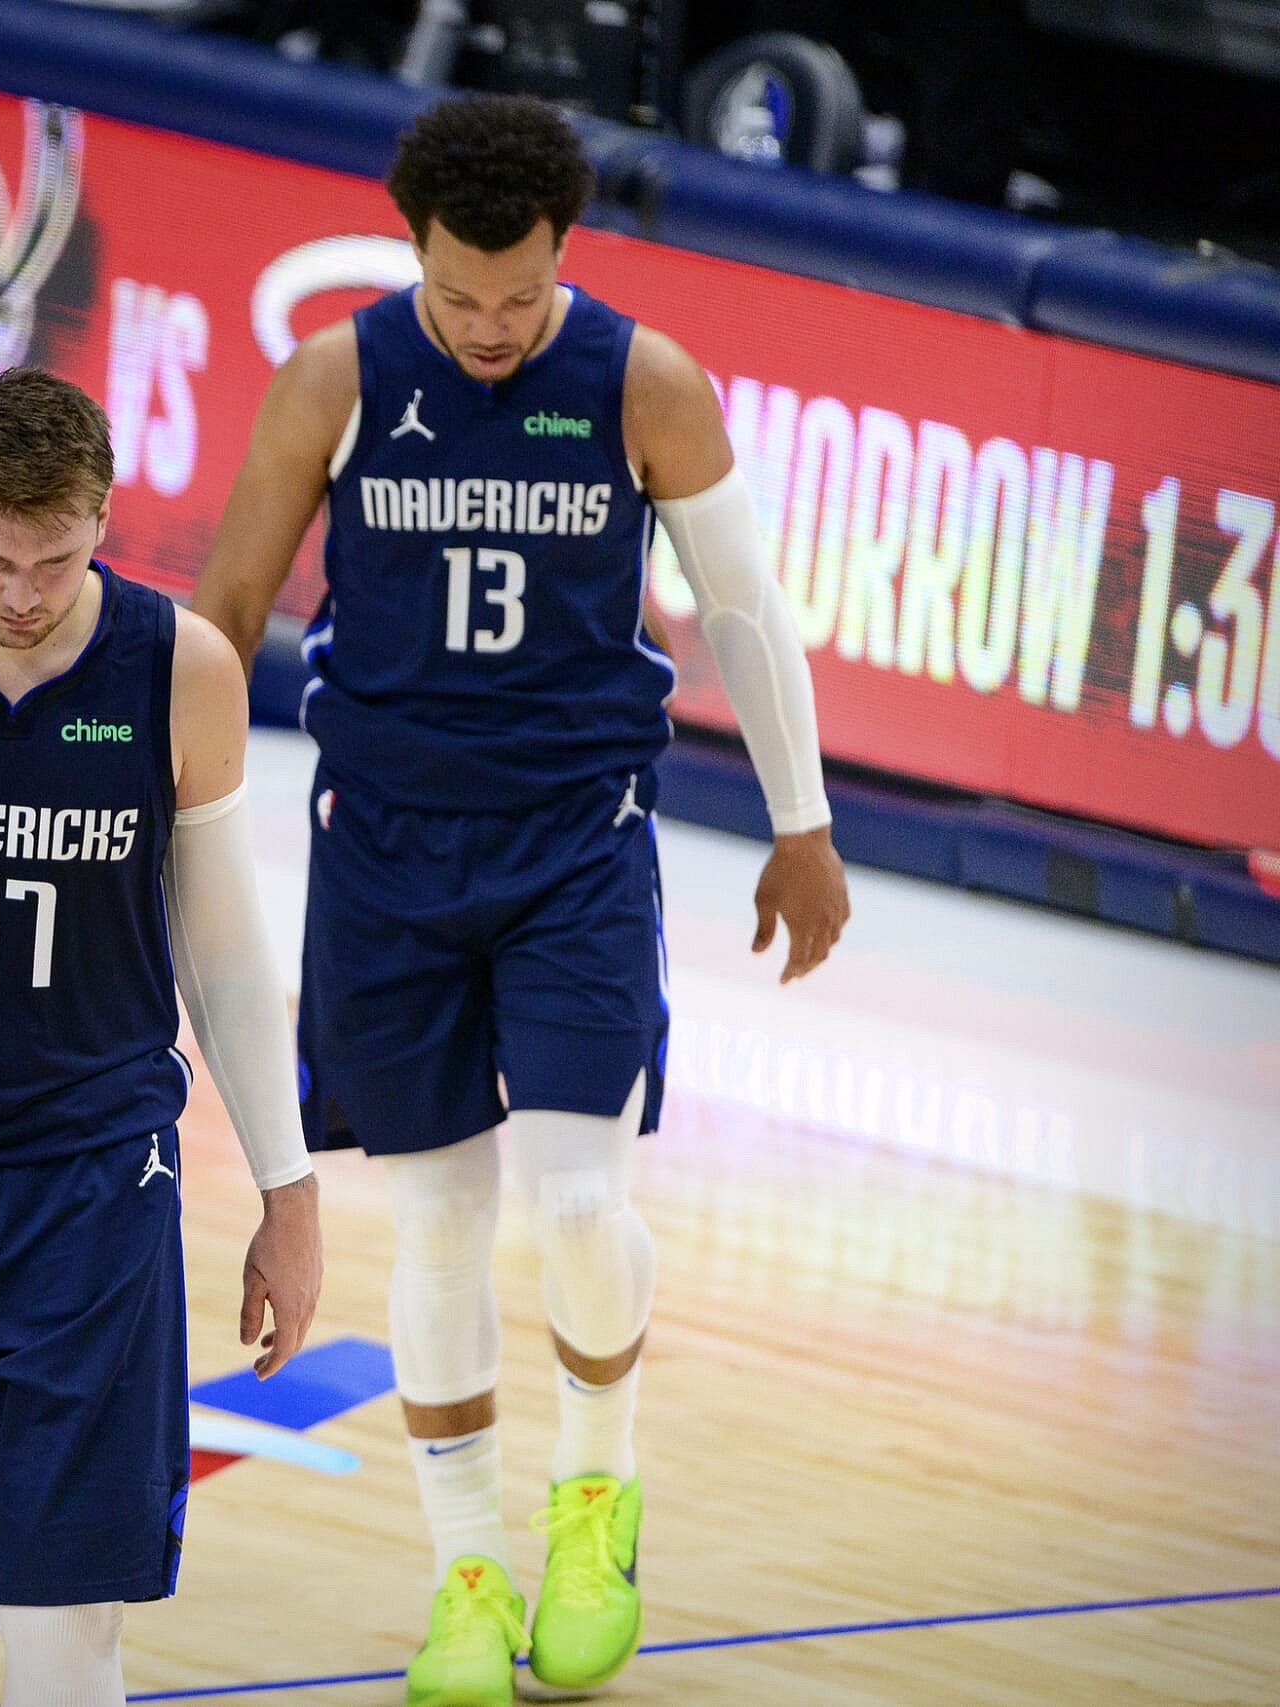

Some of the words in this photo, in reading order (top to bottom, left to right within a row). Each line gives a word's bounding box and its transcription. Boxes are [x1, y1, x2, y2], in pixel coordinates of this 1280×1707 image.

[107, 278, 210, 497] VS
[523, 411, 592, 438] chime
[360, 476, 612, 536] MAVERICKS
[442, 547, 527, 653] 13
[61, 718, 133, 742] chime
